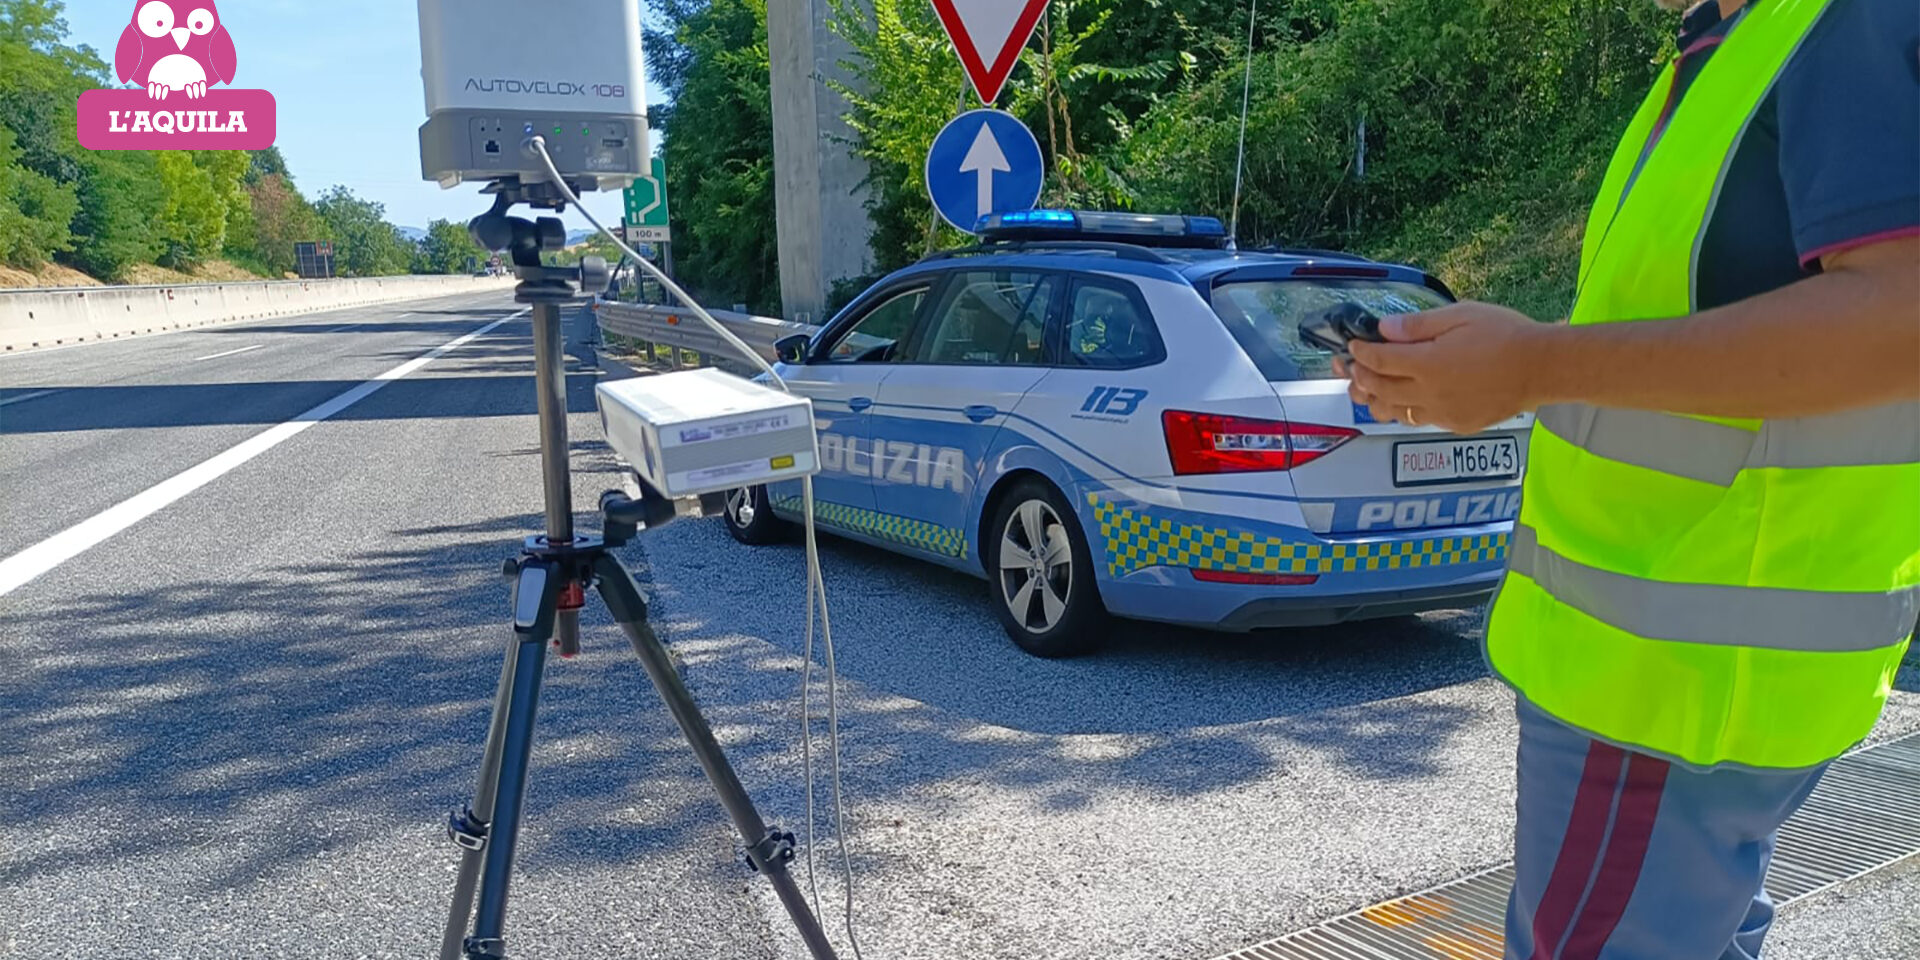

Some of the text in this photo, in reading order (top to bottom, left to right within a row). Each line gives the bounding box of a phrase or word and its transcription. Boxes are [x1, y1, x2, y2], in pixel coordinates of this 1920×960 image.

[465, 78, 625, 97] AUTOVELOX 108
[635, 230, 652, 238] 100
[1080, 386, 1149, 416] 113
[820, 433, 965, 494] OLIZIA
[1403, 443, 1514, 474] POLIZIA M6643
